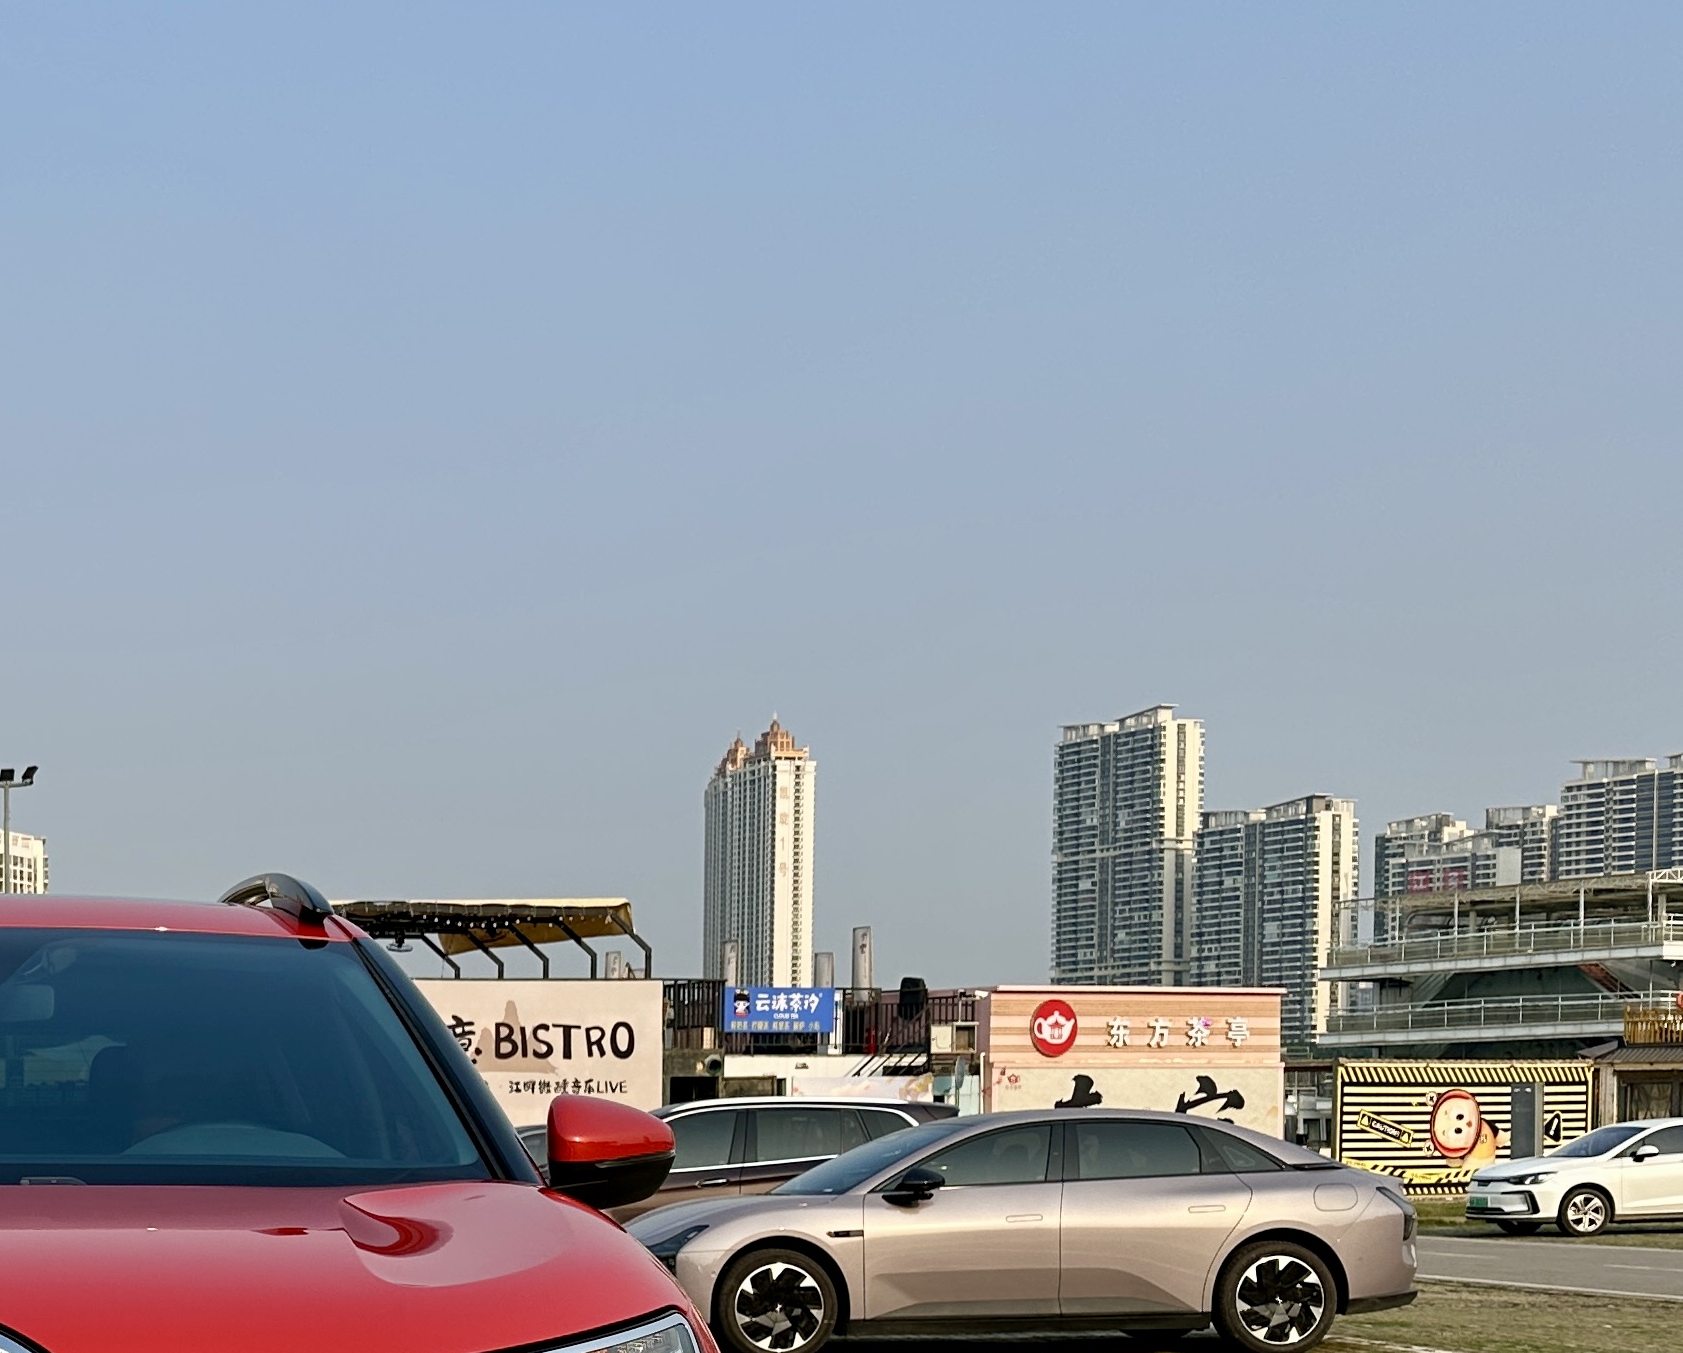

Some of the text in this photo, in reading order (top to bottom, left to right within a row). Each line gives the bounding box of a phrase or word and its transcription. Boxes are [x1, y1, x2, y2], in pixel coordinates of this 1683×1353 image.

[494, 1021, 635, 1061] BISTRO
[1106, 1016, 1251, 1049] 东方茶亭
